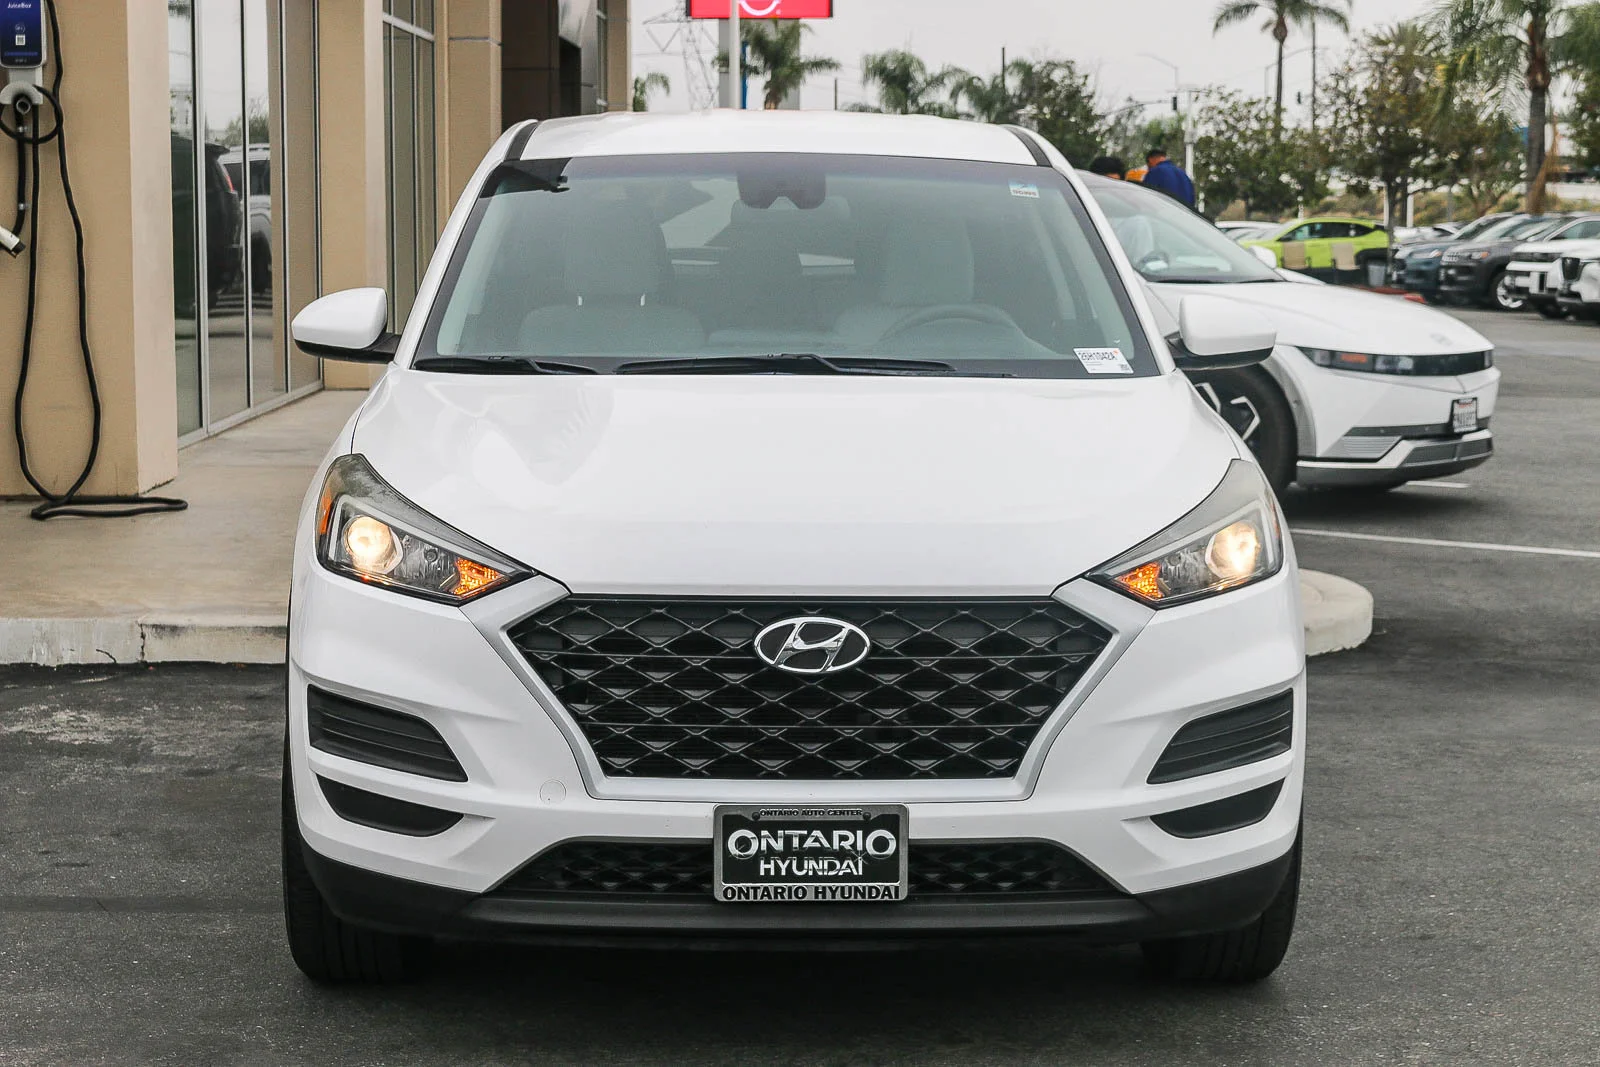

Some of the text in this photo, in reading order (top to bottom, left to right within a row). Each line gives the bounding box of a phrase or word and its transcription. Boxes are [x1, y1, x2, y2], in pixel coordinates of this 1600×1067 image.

[759, 808, 863, 817] ONTARIO AUTO CENTER
[727, 829, 897, 860] ONTARIO
[759, 857, 863, 876] HYUNDAI
[722, 886, 899, 899] ONTARIO HYUNDAI
